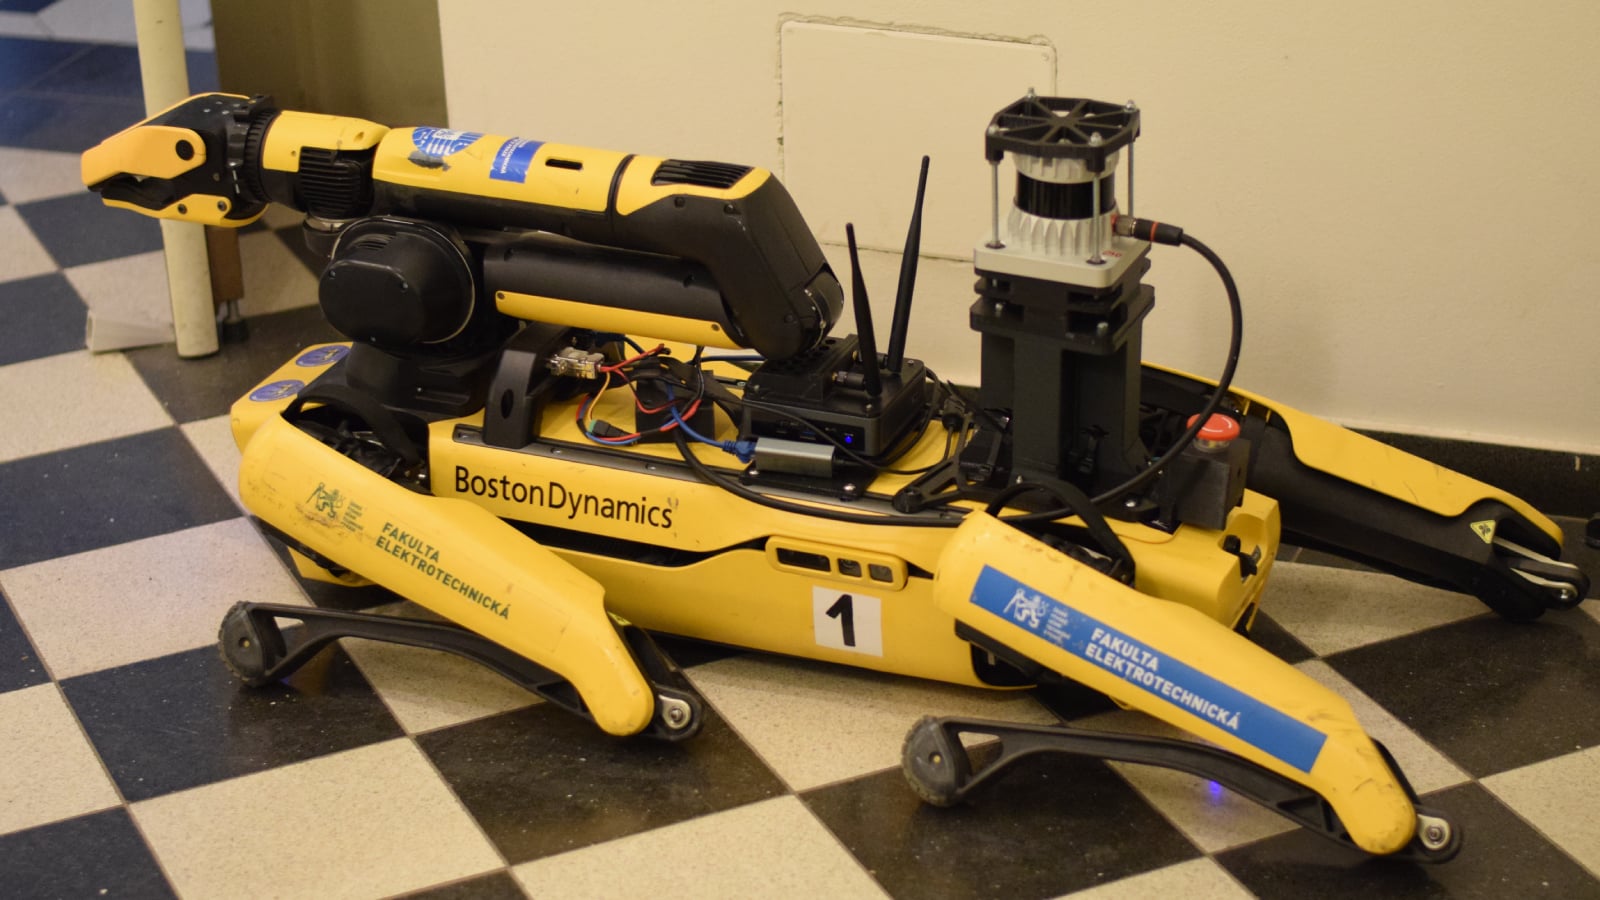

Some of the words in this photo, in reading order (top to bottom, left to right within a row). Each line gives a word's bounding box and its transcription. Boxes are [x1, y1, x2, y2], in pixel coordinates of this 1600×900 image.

[382, 522, 441, 563] FAKULTA
[375, 536, 512, 620] ELEKTROTECHNICKÁ
[825, 593, 857, 648] 1
[1090, 627, 1160, 672] FAKULTA
[1085, 642, 1242, 731] ELEKTROTECHNICKÁ
